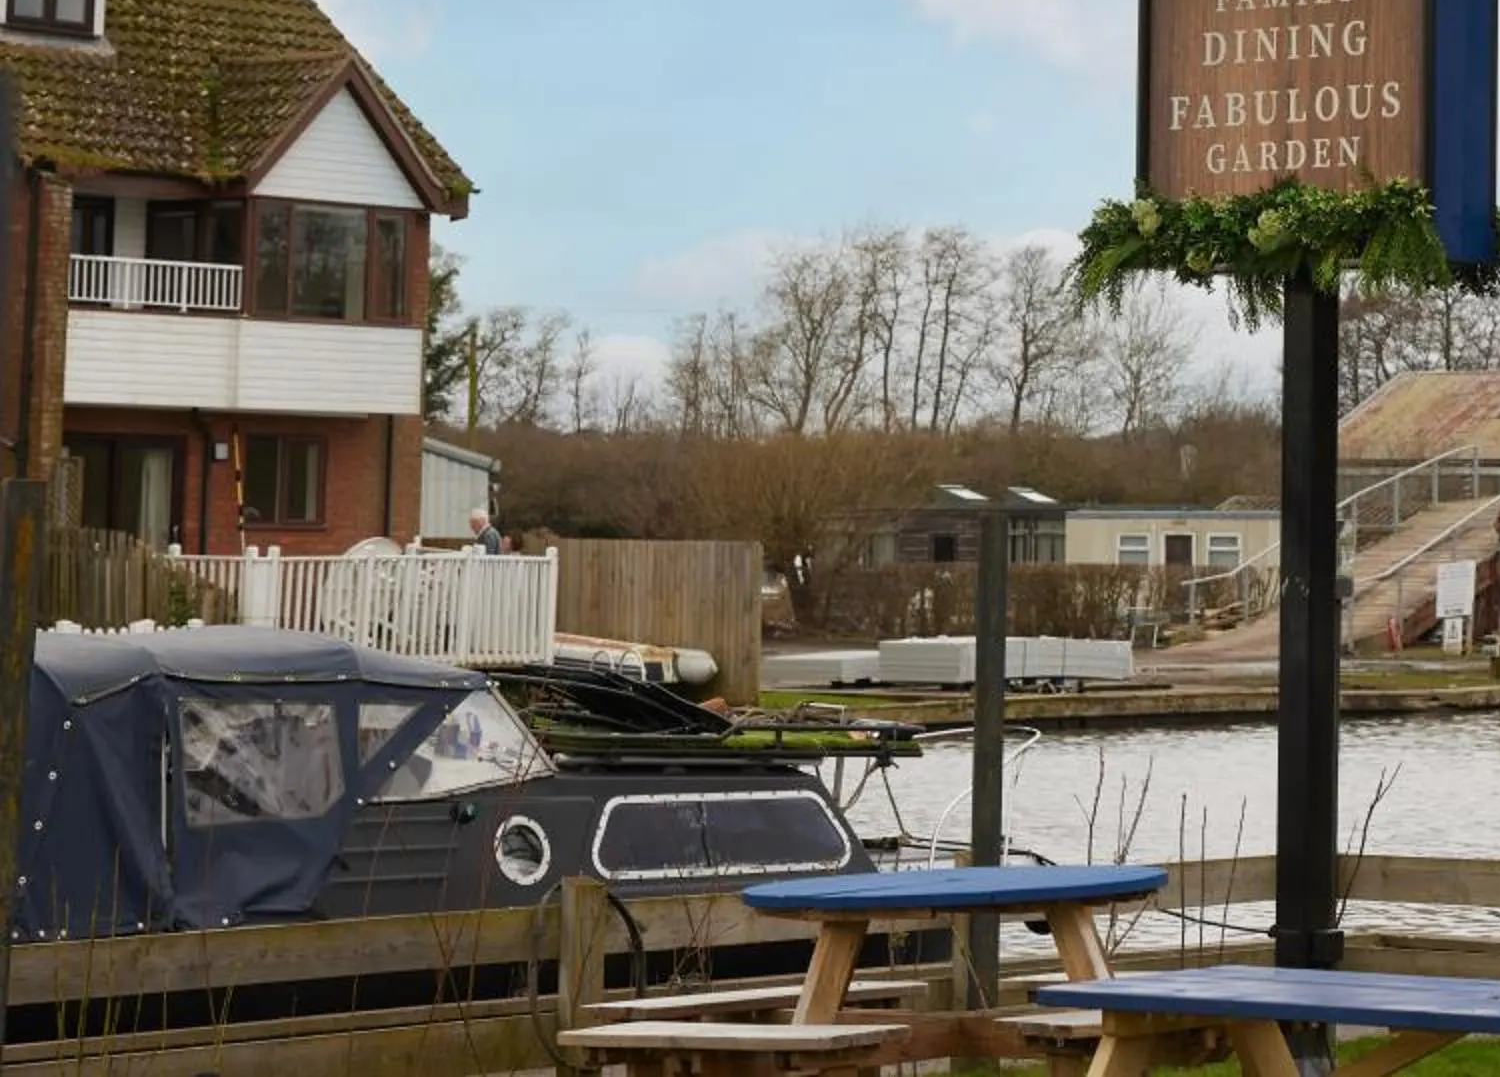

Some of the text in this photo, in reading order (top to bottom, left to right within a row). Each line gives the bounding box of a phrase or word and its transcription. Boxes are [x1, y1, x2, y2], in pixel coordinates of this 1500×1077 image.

[1201, 20, 1368, 66] DINING
[1168, 81, 1402, 131] FABULOUS
[1206, 136, 1360, 174] GARDEN
